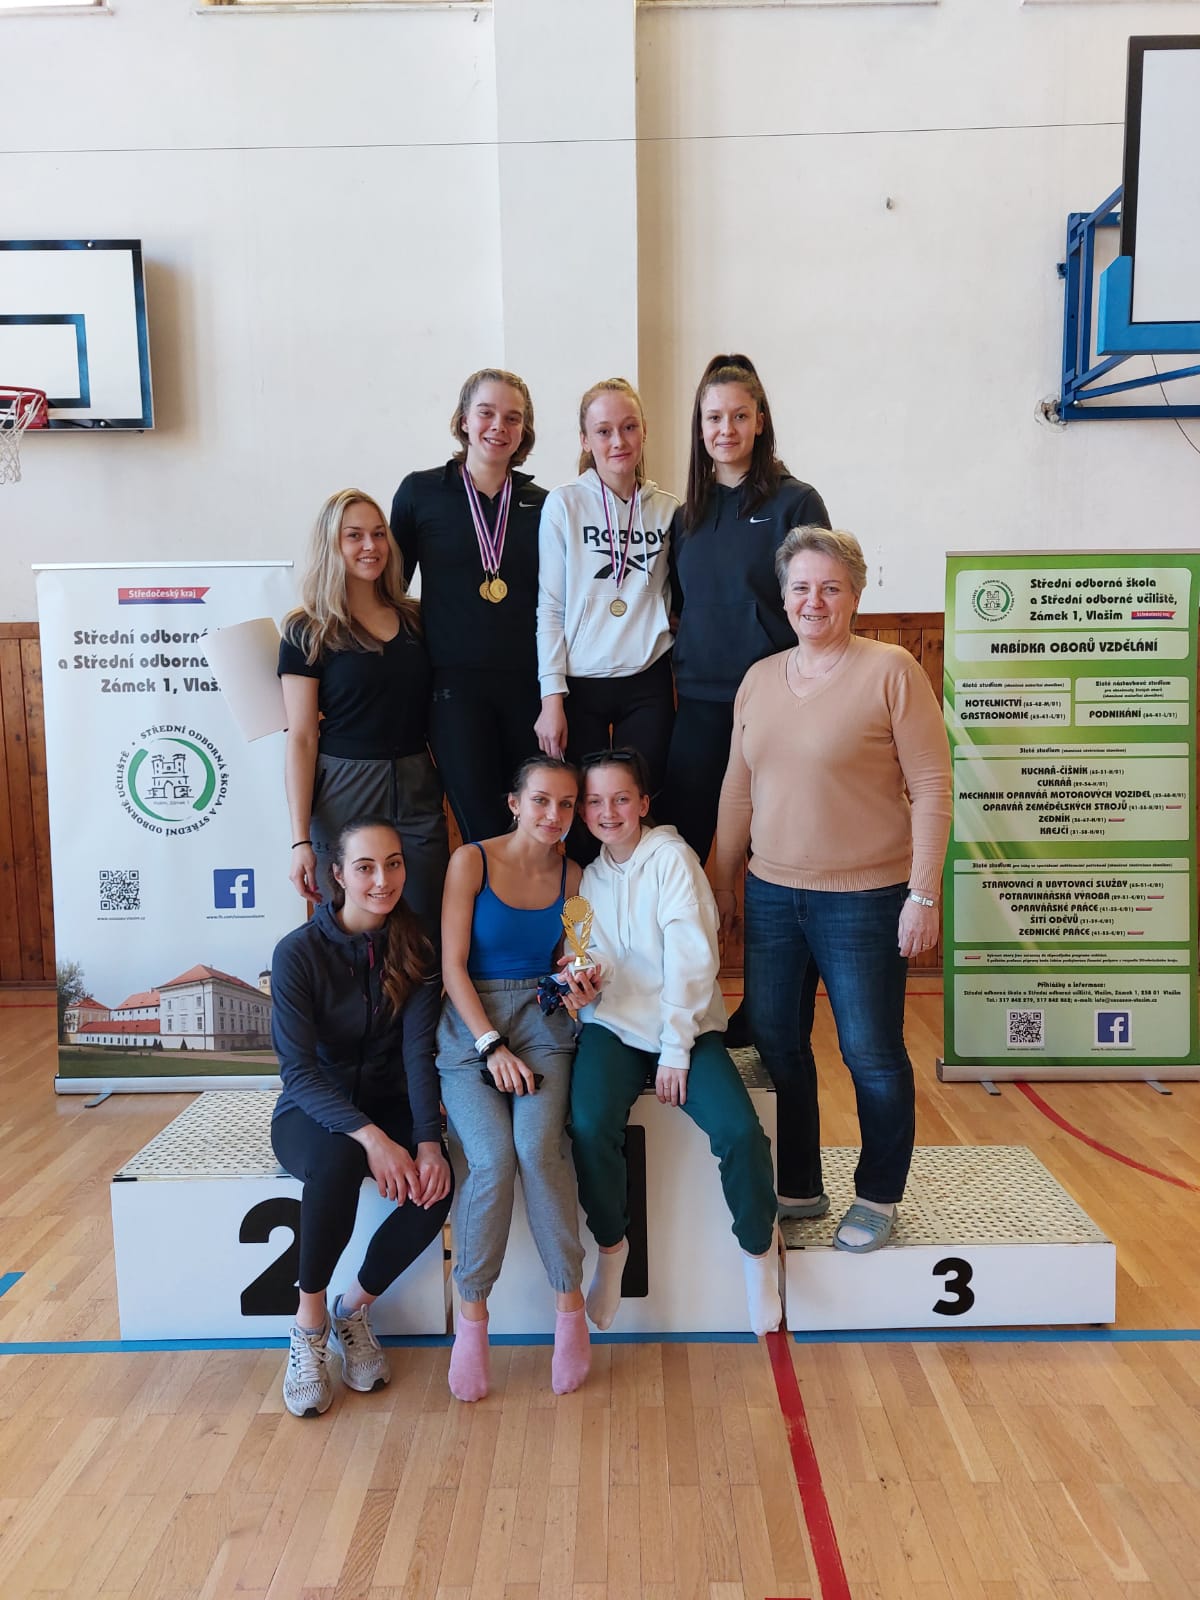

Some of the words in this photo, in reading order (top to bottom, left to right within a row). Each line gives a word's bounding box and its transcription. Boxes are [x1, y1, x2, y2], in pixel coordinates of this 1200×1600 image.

[1031, 578, 1071, 588] Střední
[1075, 577, 1122, 588] odborná
[1126, 578, 1156, 587] škola
[128, 589, 179, 598] Středočeský
[180, 589, 196, 598] kraj
[1041, 594, 1082, 604] Střední
[1086, 594, 1132, 604] odborné
[1137, 593, 1177, 605] učiliště,
[1030, 611, 1068, 621] Zámek
[1073, 611, 1082, 622] 1,
[1086, 610, 1122, 620] Vlašim
[74, 629, 134, 644] Střední
[991, 640, 1045, 653] NABÍDKA
[1050, 638, 1095, 653] OBORŮ
[1099, 638, 1157, 652] VZDĚLÁNÍ
[59, 659, 68, 669] a
[74, 653, 133, 669] Střední
[101, 678, 155, 692] Zámek
[163, 678, 177, 694] 1,
[184, 677, 221, 692] Vlaš
[965, 699, 1021, 707] HOTELNICTVÍ
[961, 712, 1028, 720] GASTRONOMIE
[1089, 708, 1141, 718] PODNIKÁNÍ
[140, 725, 186, 739] STŘEDNÍ
[188, 729, 227, 770] ODBORNÁ
[1022, 765, 1087, 775] KUCHAŘ-ČÍŠNÍK
[1037, 777, 1071, 786] CUKRÁŘ
[215, 773, 229, 806] ŠKOLA
[1007, 790, 1047, 799] OPRAVÁŘ
[1050, 789, 1112, 798] MOTOROVÝCH
[983, 802, 1023, 811] OPRAVÁŘ
[1095, 800, 1127, 810] STROJŮ
[122, 799, 162, 834] ODBORNÉ
[1039, 813, 1070, 822] ZEDNÍK
[166, 815, 210, 837] STŘEDNÍ
[1040, 825, 1068, 834] KREJČÍ
[982, 879, 1033, 888] STRAVOVACÍ
[1046, 879, 1093, 888] UBYTOVACÍ
[1096, 878, 1127, 887] SLUŽBY
[1074, 890, 1109, 899] VÝROBA
[1011, 903, 1068, 912] OPRAVÁŘSKÉ
[1071, 902, 1098, 911] PRÁCE
[1030, 913, 1046, 923] ŠITÍ
[1049, 913, 1078, 923] ODĚVŮ
[1019, 926, 1060, 935] ZEDNICKÉ
[1063, 926, 1089, 935] PRÁCE
[239, 1197, 301, 1316] 2
[932, 1257, 975, 1316] 3
